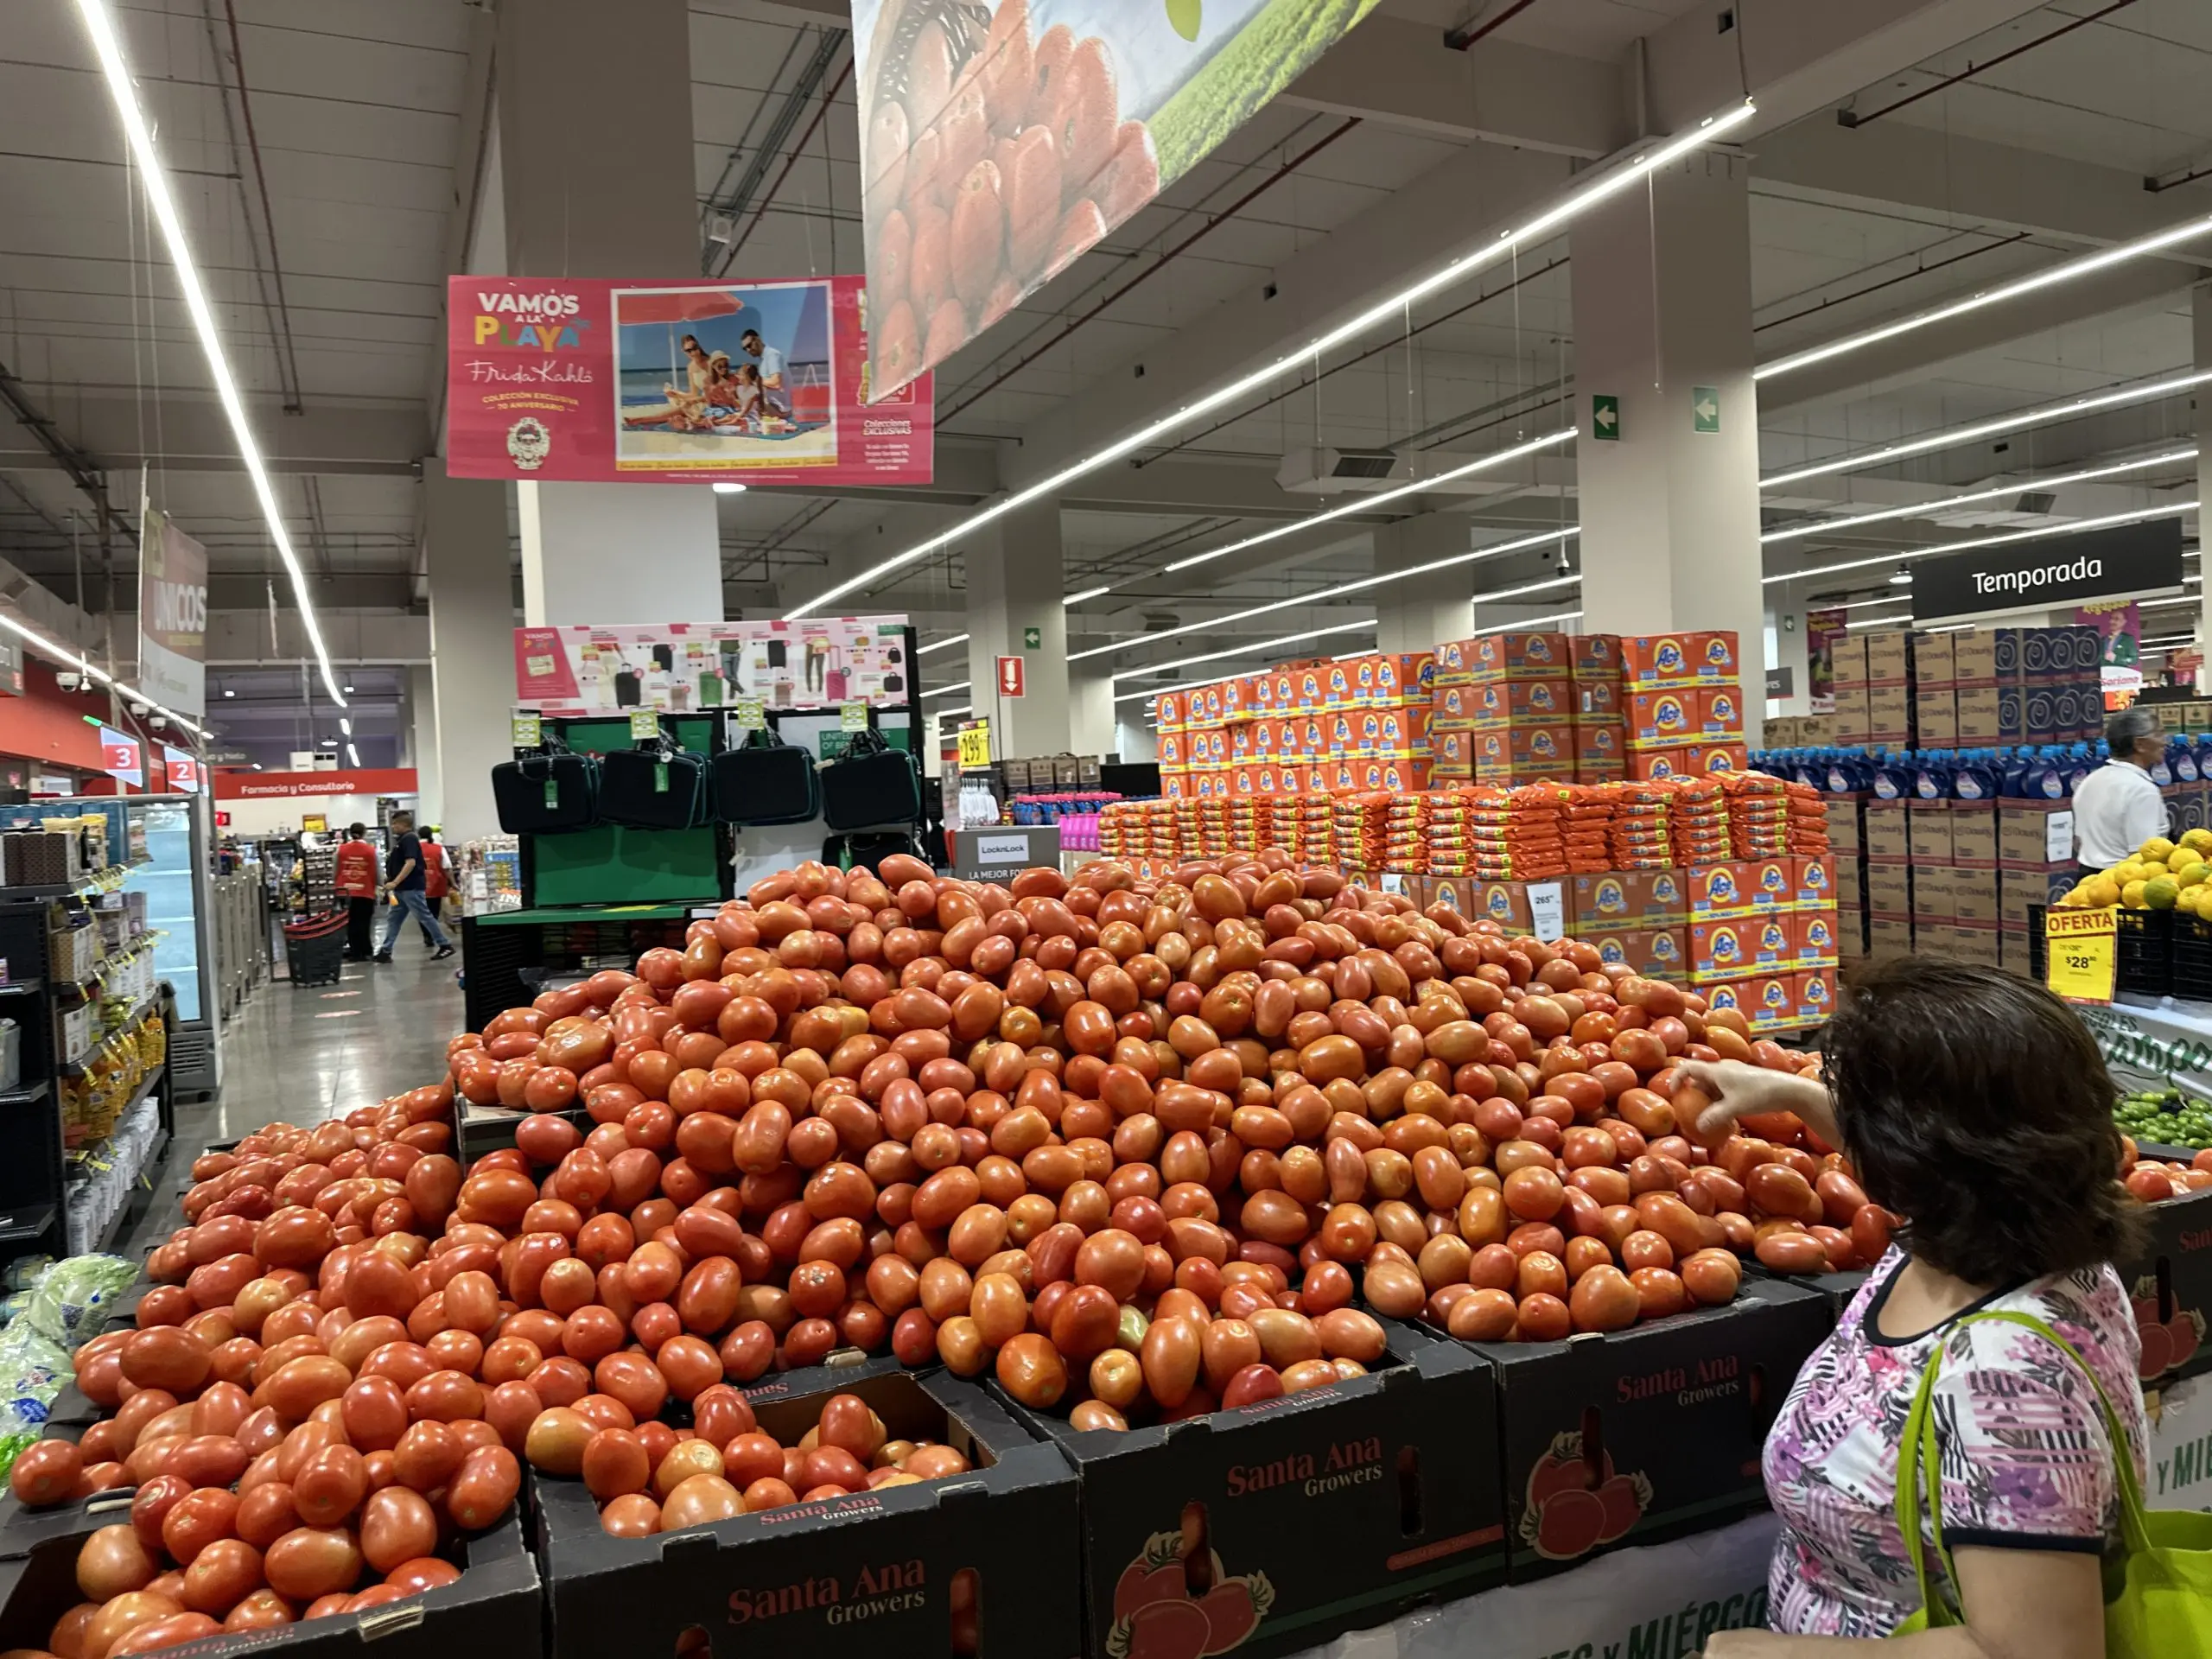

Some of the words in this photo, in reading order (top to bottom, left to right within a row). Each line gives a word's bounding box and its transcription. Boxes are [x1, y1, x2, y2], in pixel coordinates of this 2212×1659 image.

[477, 292, 580, 316] VAMOS
[526, 315, 542, 323] LA
[475, 315, 580, 353] PLAYA
[464, 359, 536, 384] Frida
[531, 359, 594, 383] Kahlo
[510, 402, 565, 412] ANIVERSARIO
[534, 392, 579, 406] EXCLUSIVA
[1972, 556, 2102, 594] Temporada
[1654, 647, 1681, 668] Ace
[1654, 704, 1681, 725] Ace
[1713, 701, 1731, 716] Ace
[115, 747, 131, 767] 3
[176, 763, 189, 779] 2
[241, 784, 289, 795] Farmacia
[290, 786, 297, 795] y
[299, 781, 355, 791] Consultorio
[982, 845, 1025, 854] LocknLock
[969, 871, 979, 880] LA
[981, 869, 1008, 879] MEJOR
[1761, 871, 1781, 887] Ace
[1804, 868, 1825, 885] Ace
[1707, 875, 1733, 897] Ace
[1487, 893, 1508, 911] Ace
[1598, 887, 1622, 908] Ace
[2048, 912, 2114, 932] OFERTA
[1712, 934, 1738, 959] Ace
[2178, 1229, 2212, 1253] San
[1617, 1366, 1687, 1404] Santa
[1694, 1354, 1739, 1383] Ana
[1239, 1395, 1294, 1415] Santa
[1299, 1387, 1337, 1401] Ana
[1677, 1379, 1740, 1408] Growers
[1226, 1452, 1315, 1497] Santa
[1324, 1435, 1382, 1472] Ana
[1304, 1465, 1383, 1497] Growers
[760, 1503, 829, 1526] Santa
[836, 1496, 881, 1512] Ana
[822, 1503, 884, 1521] Growers
[728, 1576, 841, 1625] Santa
[850, 1558, 926, 1599] Ana
[826, 1590, 926, 1626] Growers
